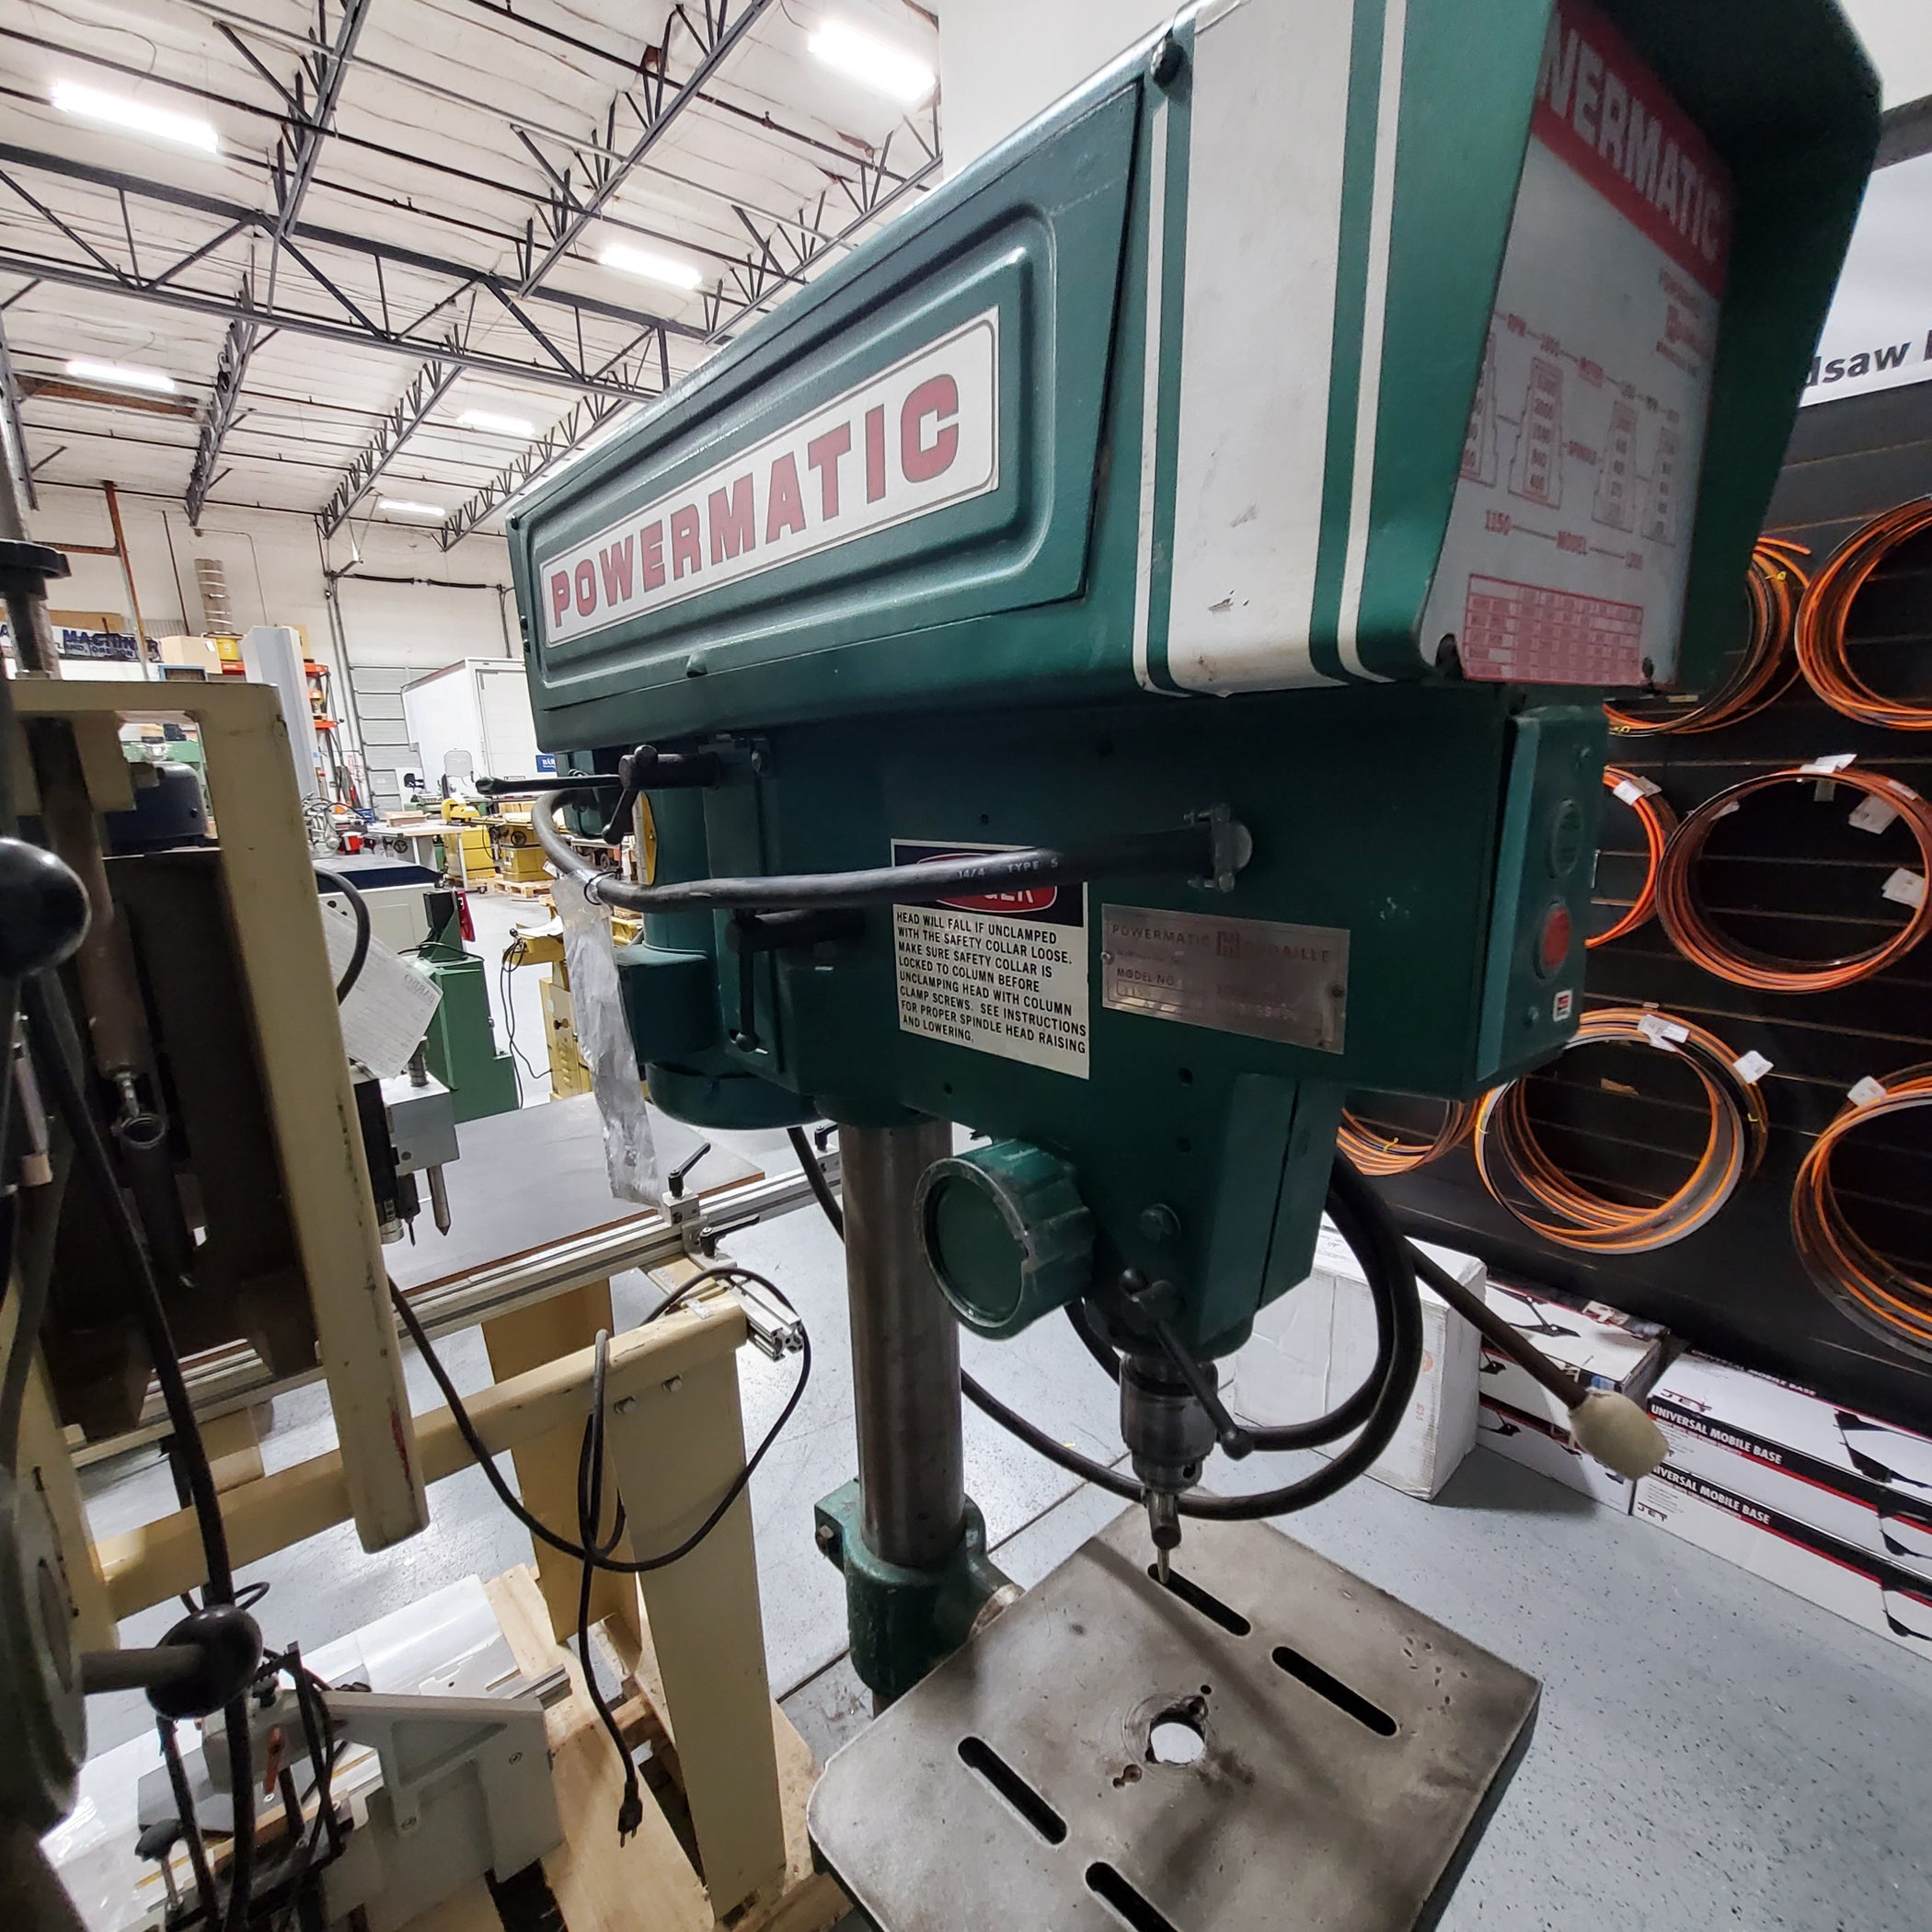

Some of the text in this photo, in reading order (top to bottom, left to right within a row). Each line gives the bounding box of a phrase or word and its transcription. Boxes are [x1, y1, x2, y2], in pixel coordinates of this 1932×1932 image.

[1535, 7, 1721, 264] WERMATIC
[551, 374, 959, 627] POWERMATIC
[1006, 859, 1040, 873] TYPE
[896, 911, 1057, 944] HEAD WILL FALL IF UNCLAMPED
[897, 926, 1072, 965] WITH THE SAFETY COLLAR LOOSE.
[1112, 924, 1211, 948] POWERMATIC
[898, 941, 1052, 978] MAKE SURE SAFETY COLLAR IS
[899, 957, 1040, 993] LOCKED TO COLUMN BEFORE
[1116, 968, 1153, 983] MODEL
[900, 971, 1072, 1016] UNCLAMPING HEAD WITH COLUMN
[900, 985, 1087, 1037] CLAMP SCREWS. SEE INSTRUCTIONS
[902, 1000, 1086, 1053] FOR PROPER SPINDLE HEAD RAISING
[903, 1015, 974, 1041] AND LOWERING.
[1747, 1369, 1788, 1386] MOBILE
[1788, 1383, 1817, 1397] BASE
[1650, 1403, 1708, 1435] UNIVERSAL
[1709, 1429, 1752, 1453] MOBILE
[1753, 1444, 1783, 1466] BASE
[1638, 1503, 1668, 1523] JET
[1653, 1465, 1697, 1491] IVERSAL
[1699, 1484, 1741, 1511] MOBILE
[1742, 1503, 1771, 1524] BASE
